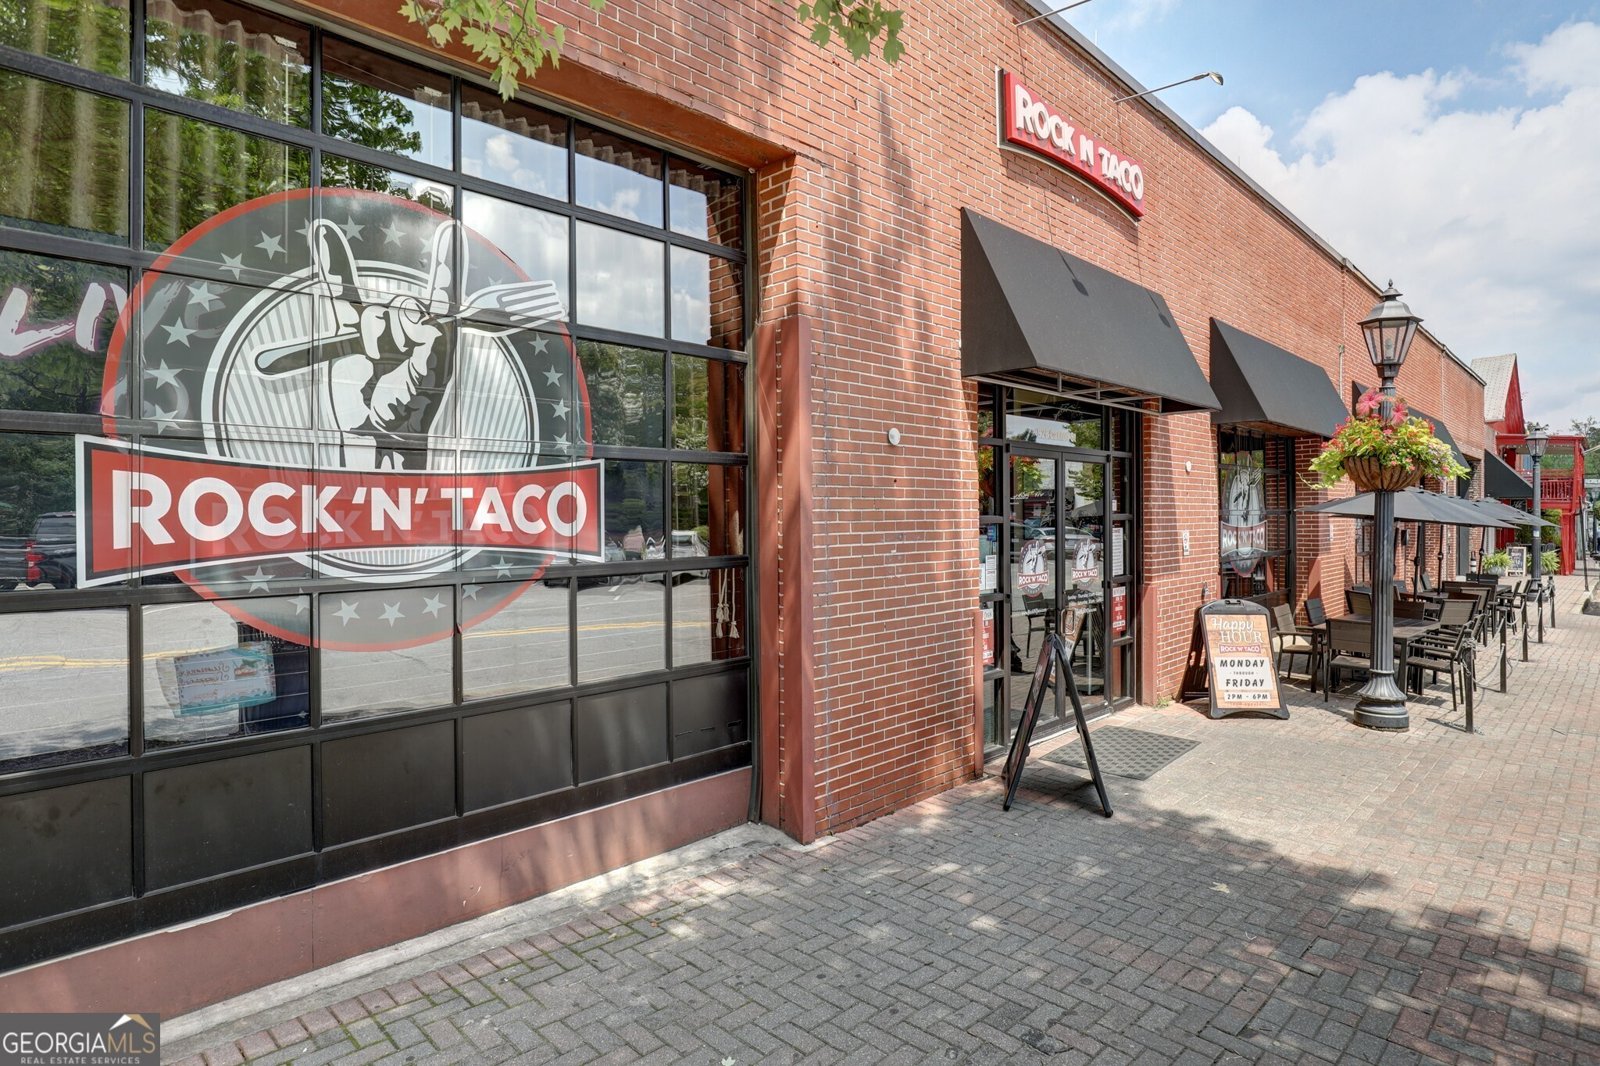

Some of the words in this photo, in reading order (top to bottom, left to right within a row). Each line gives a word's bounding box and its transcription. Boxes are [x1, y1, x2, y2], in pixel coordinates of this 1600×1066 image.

[1015, 84, 1076, 157] ROCK
[1080, 134, 1094, 168] N
[1098, 146, 1144, 201] TACO
[111, 469, 343, 549] ROCK
[440, 481, 587, 538] TACO
[1072, 570, 1082, 578] ROCK
[1018, 575, 1031, 585] ROCK
[1211, 617, 1254, 633] Happy
[1220, 631, 1263, 643] HOUR
[1220, 645, 1236, 653] ROCK
[1244, 645, 1260, 653] TACO
[1220, 659, 1265, 668] MONDAY
[1226, 679, 1265, 687] FRIDAY
[1227, 692, 1242, 700] 2PM
[1252, 692, 1268, 700] 6PM
